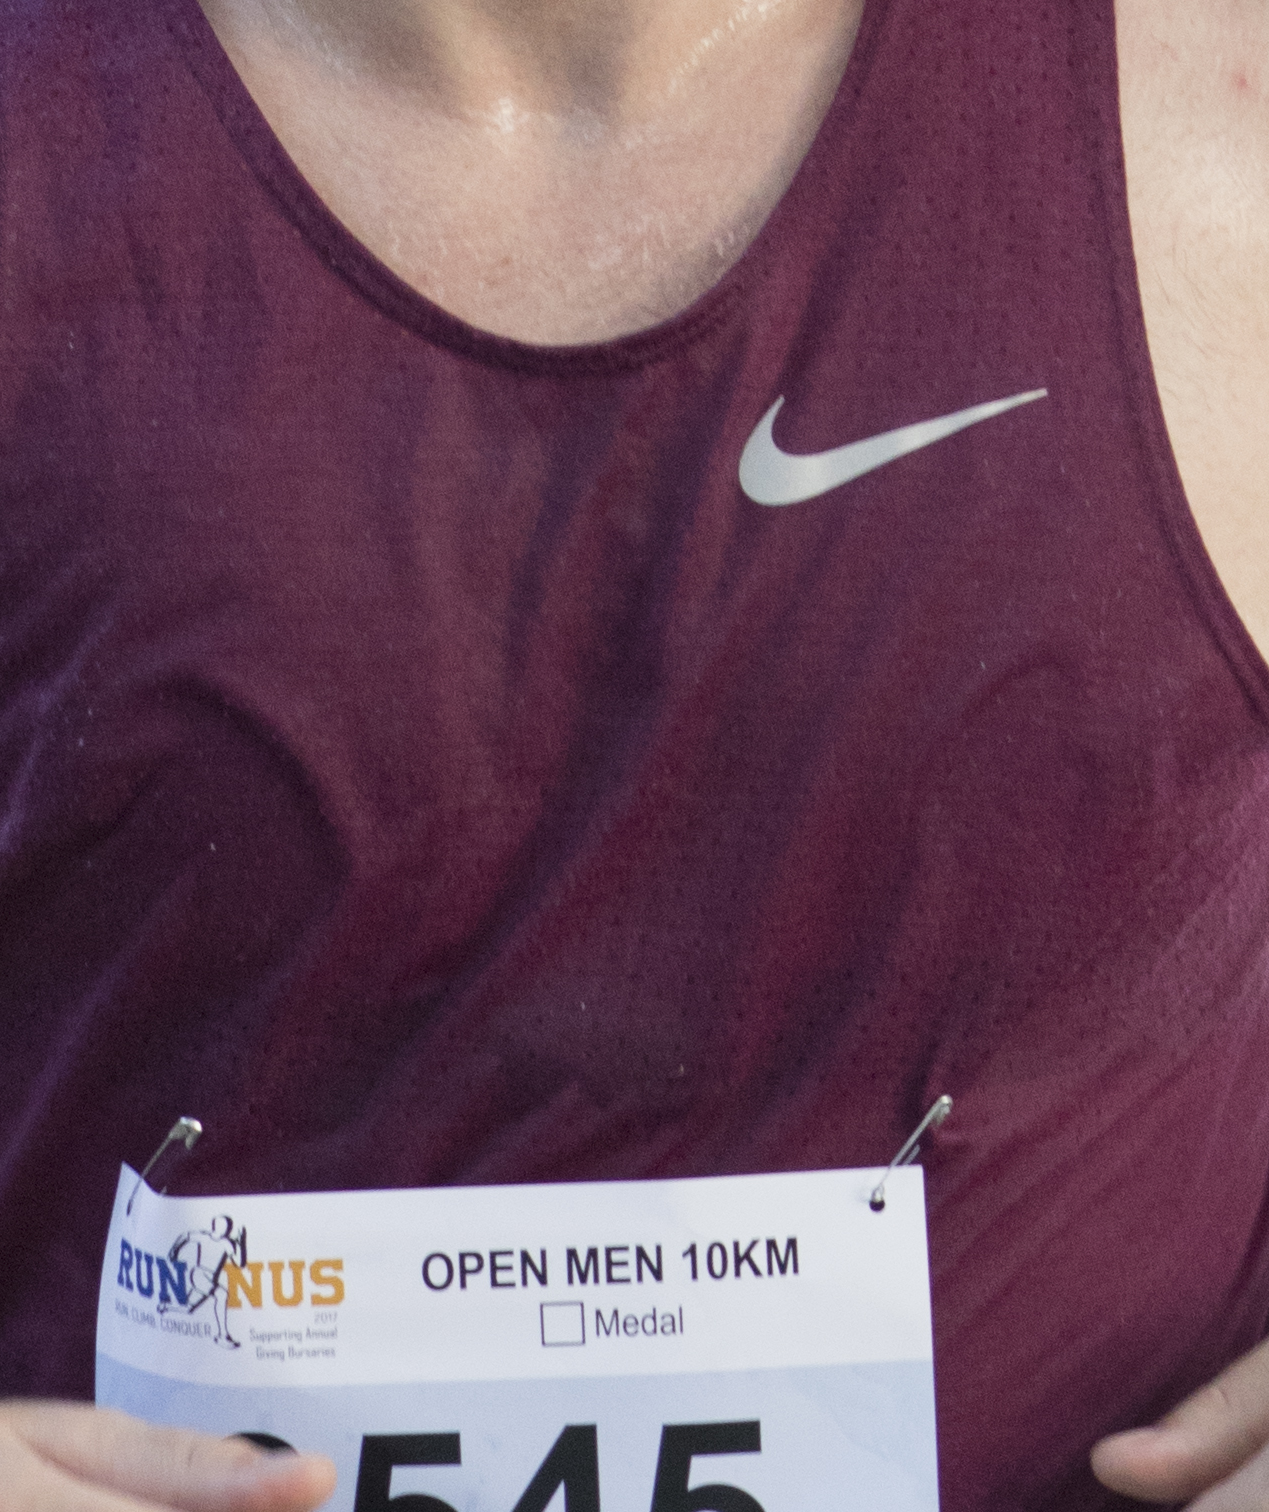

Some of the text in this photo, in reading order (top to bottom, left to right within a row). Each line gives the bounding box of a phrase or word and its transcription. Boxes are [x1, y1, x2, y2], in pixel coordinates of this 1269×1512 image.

[116, 1238, 346, 1310] RUN NUS
[421, 1236, 800, 1291] OPEN MEN 10KM
[314, 1311, 338, 1324] 2017
[594, 1305, 685, 1338] Medal
